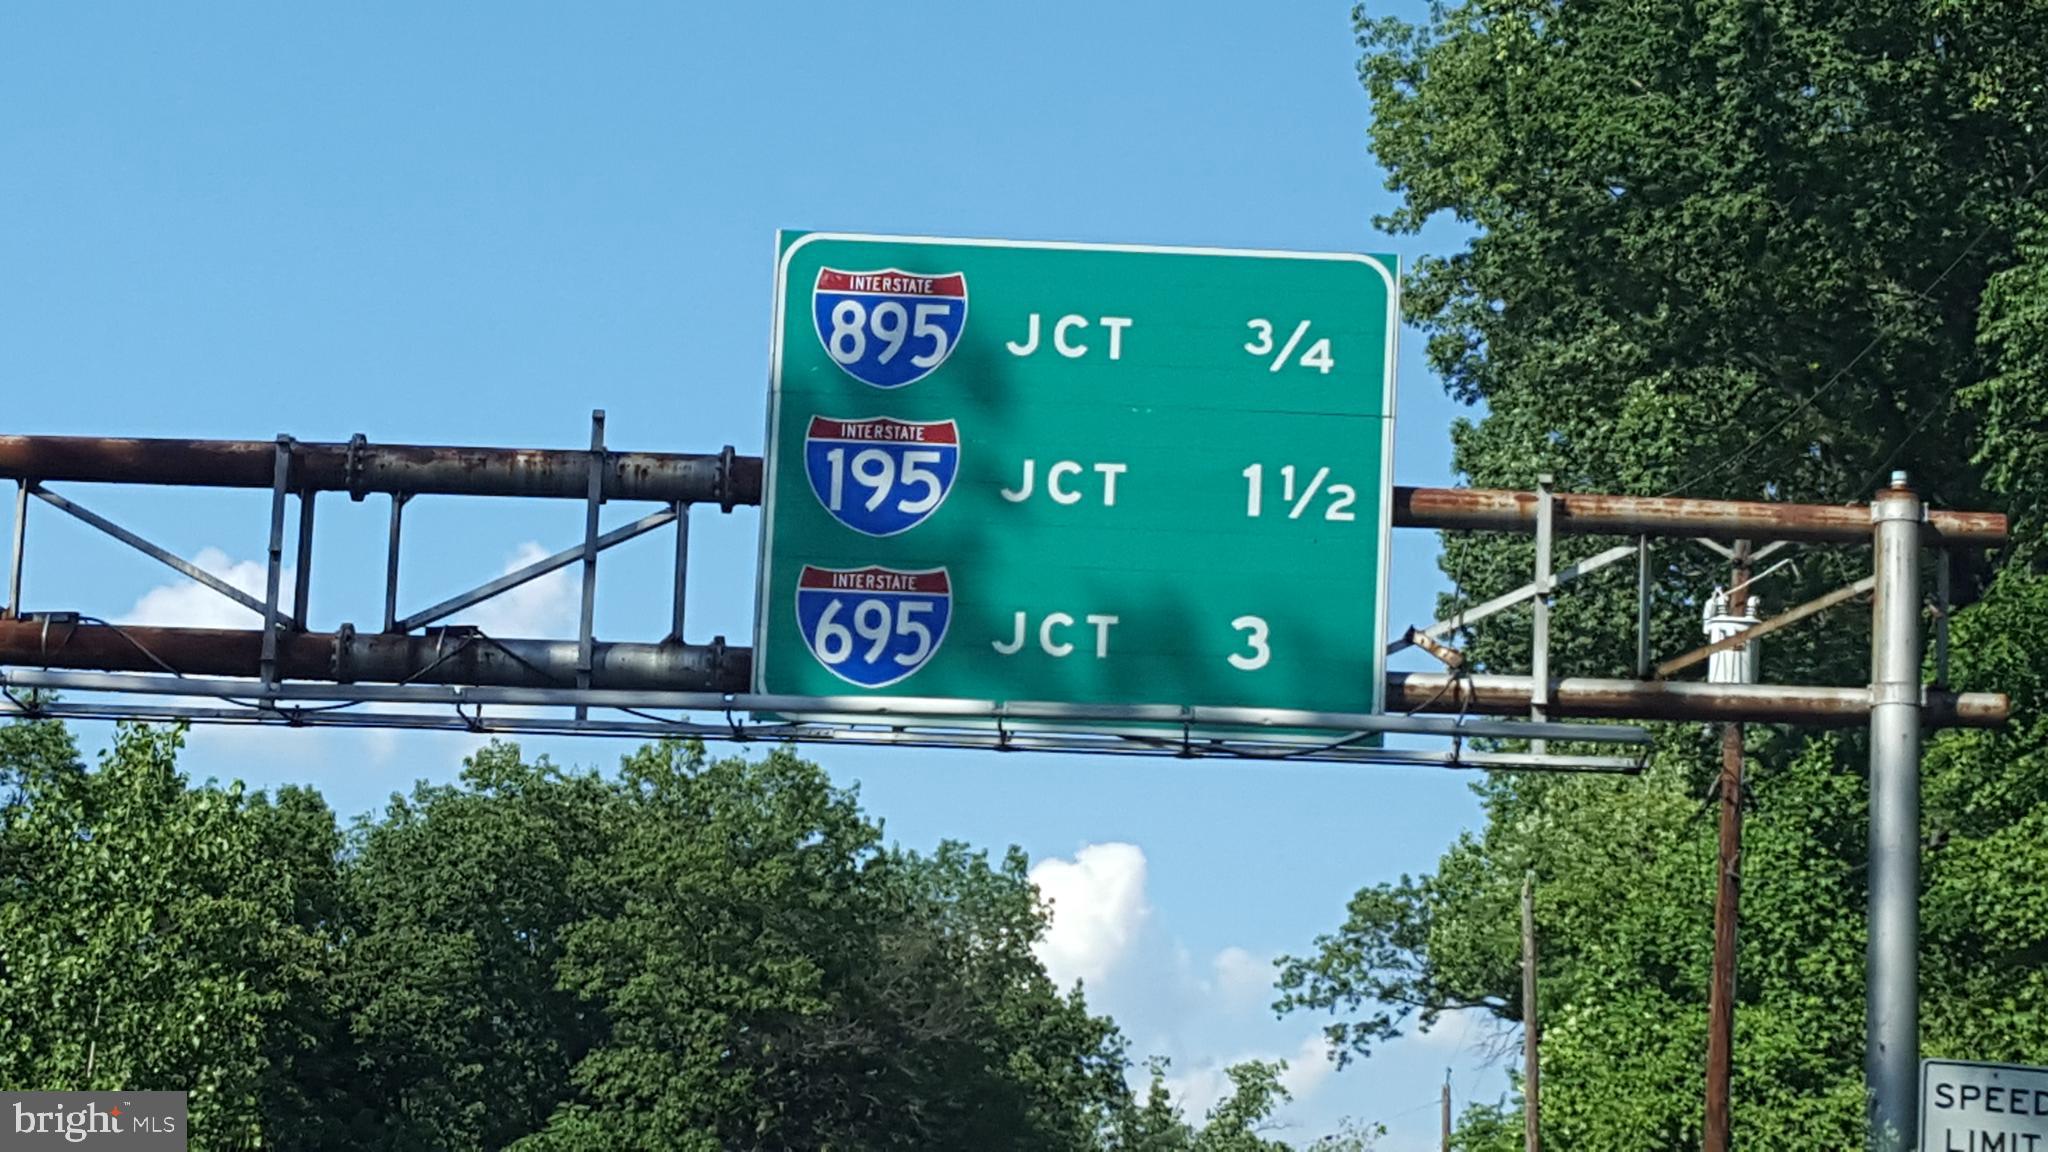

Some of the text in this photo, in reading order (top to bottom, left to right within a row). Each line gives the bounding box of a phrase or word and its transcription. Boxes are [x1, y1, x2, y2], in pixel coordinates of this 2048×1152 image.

[849, 276, 934, 294] INTERSTATE
[830, 300, 1335, 374] 895 JCT 3/4
[841, 423, 925, 441] INTERSTATE
[825, 449, 1356, 521] 195 JCT 1 1/2
[832, 573, 917, 591] INTERSTATE
[814, 599, 1272, 671] 695 JCT 3
[1934, 1082, 2048, 1116] SPEED
[1946, 1128, 2041, 1152] LIMIT
